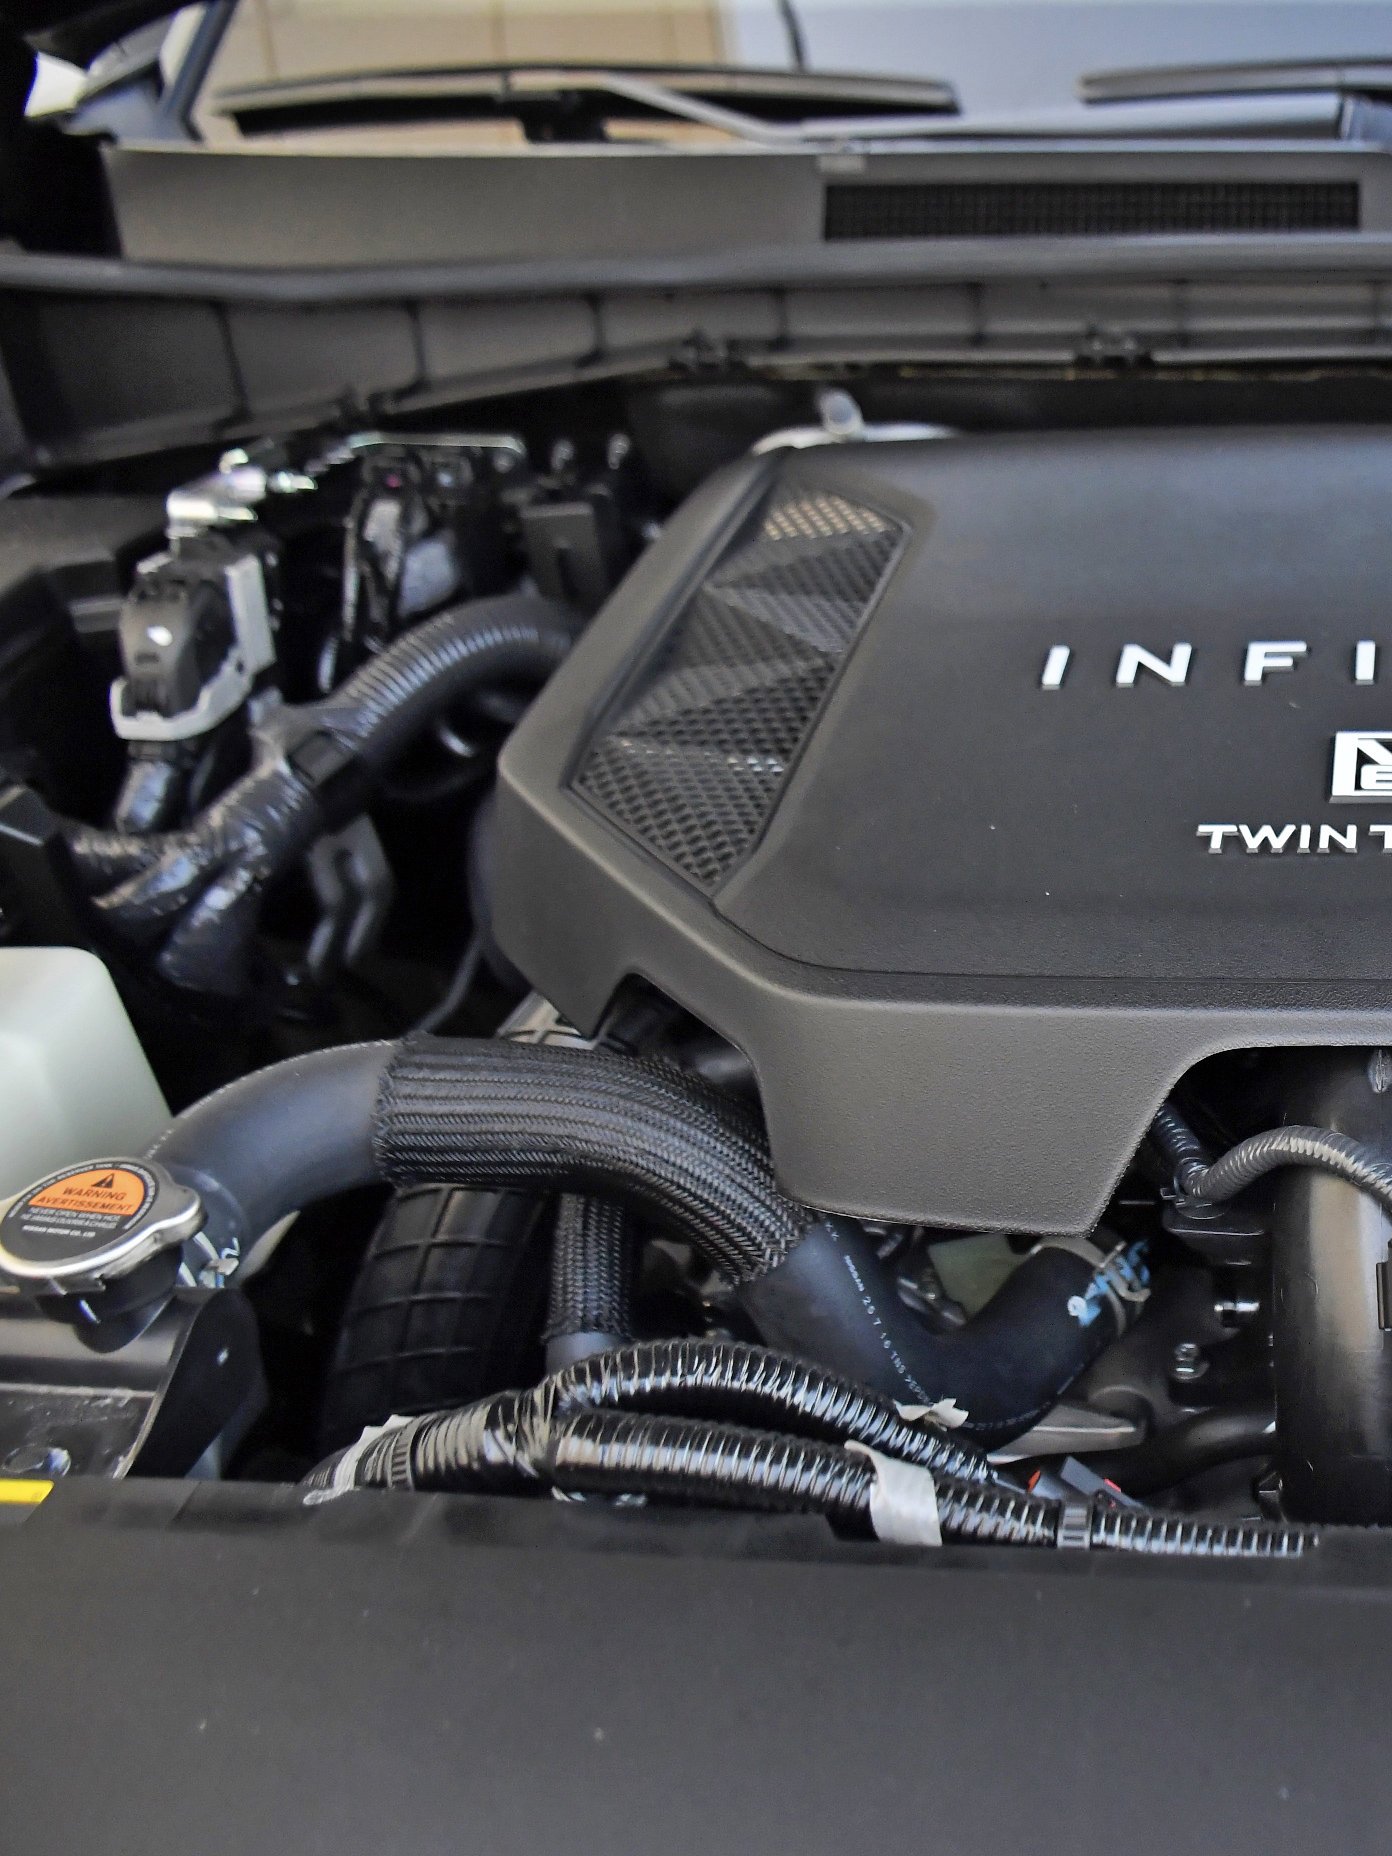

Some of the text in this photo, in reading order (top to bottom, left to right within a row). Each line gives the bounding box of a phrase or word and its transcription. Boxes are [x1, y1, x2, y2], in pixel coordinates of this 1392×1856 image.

[1196, 824, 1358, 854] TWIN
[62, 1187, 127, 1200] WARNING
[38, 1196, 132, 1211] AVERTISSEMENT
